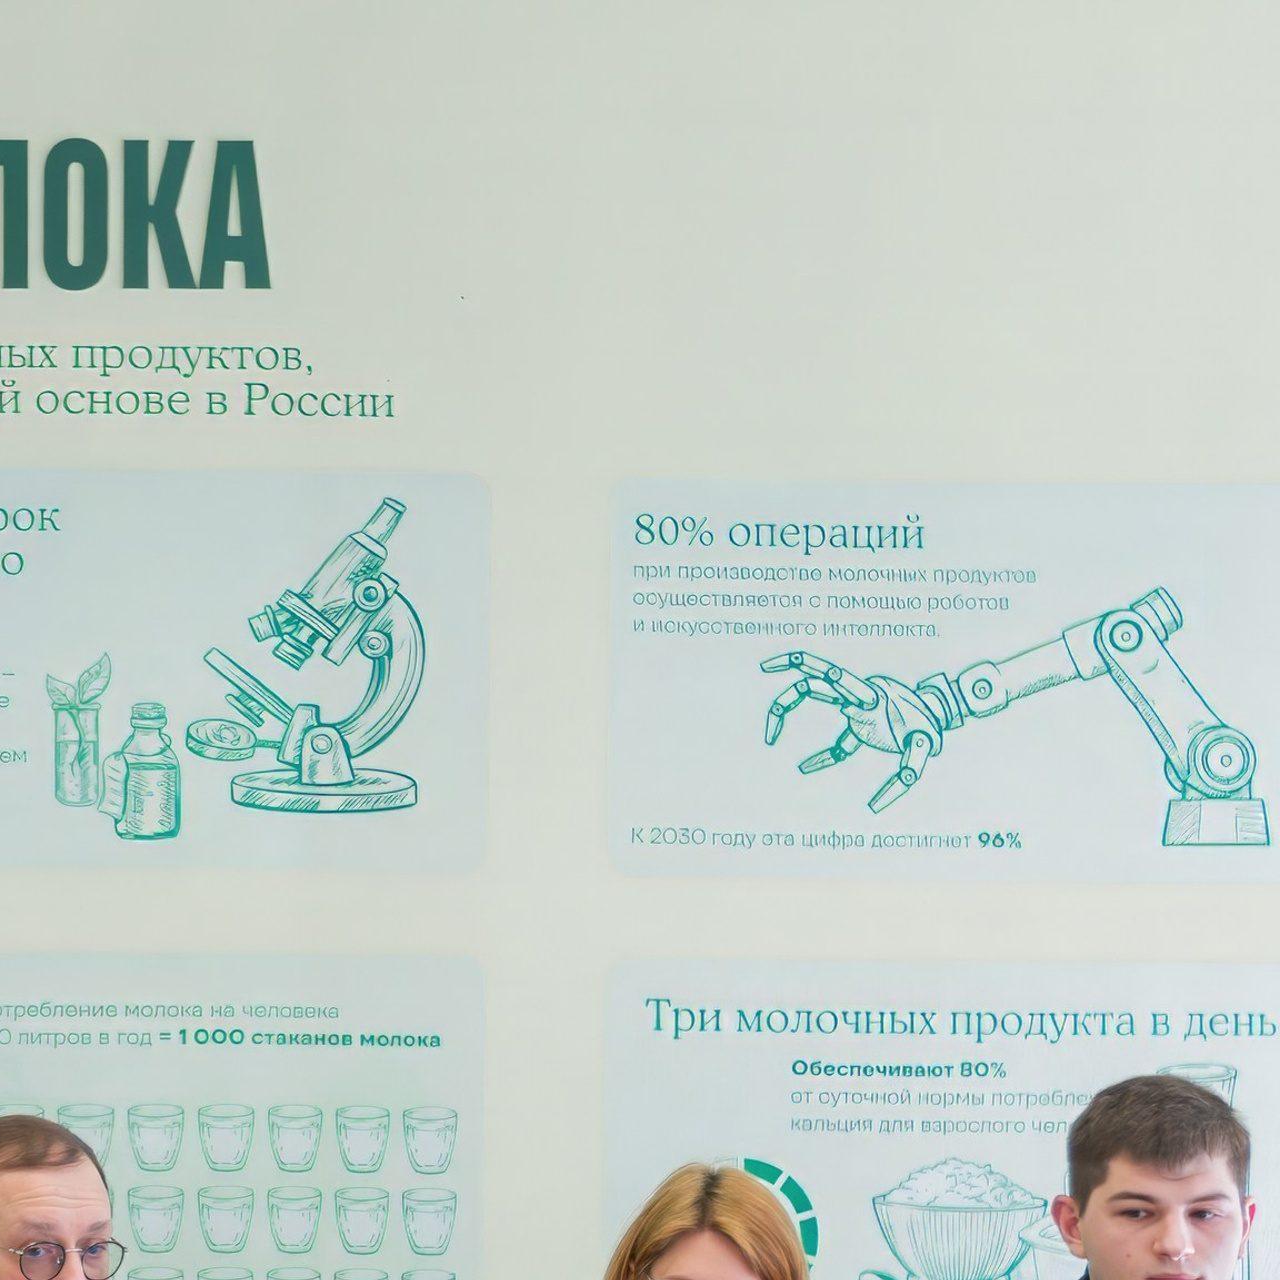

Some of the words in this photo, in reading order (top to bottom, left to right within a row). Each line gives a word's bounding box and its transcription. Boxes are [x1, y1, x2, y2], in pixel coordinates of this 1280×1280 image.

[72, 344, 312, 379] продуктов,
[36, 390, 190, 416] основе
[206, 391, 227, 415] в
[244, 382, 394, 418] России
[635, 513, 714, 546] 80%
[729, 514, 924, 556] операций
[634, 565, 670, 582] при
[678, 565, 822, 582] производстве
[829, 567, 926, 583] молочных
[934, 568, 1036, 585] продуктов
[633, 592, 802, 610] осуществляется
[809, 595, 820, 608] с
[827, 596, 921, 611] помощью
[928, 593, 1009, 614] роботов
[634, 620, 644, 633] и
[651, 620, 818, 637] искусственного
[823, 623, 941, 637] интеллекта.
[632, 828, 643, 844] К
[651, 827, 706, 845] 2030
[713, 833, 756, 849] году
[762, 833, 794, 847] эта
[802, 830, 864, 850] цифра
[871, 834, 971, 849] достигнет
[978, 830, 1022, 849] 96%
[125, 1004, 202, 1018] молока
[211, 1004, 235, 1018] на
[243, 1005, 338, 1018] человека
[646, 998, 721, 1041] Три
[737, 1009, 936, 1036] молочных
[951, 1011, 1135, 1045] продукта
[1152, 1013, 1170, 1036] в
[1184, 1012, 1276, 1041] день
[19, 1033, 91, 1048] литров
[100, 1032, 109, 1045] в
[118, 1033, 151, 1046] год
[251, 1032, 352, 1046] стаканов
[360, 1033, 441, 1047] молока
[792, 1060, 954, 1078] Обеспечивают
[961, 1061, 1006, 1078] 80%
[791, 1091, 813, 1104] от
[819, 1088, 911, 1108] суточной
[919, 1091, 984, 1109] нормы
[991, 1089, 1092, 1110] потребле
[791, 1119, 872, 1133] кальция
[879, 1119, 914, 1134] для
[922, 1119, 1025, 1136] взрослого
